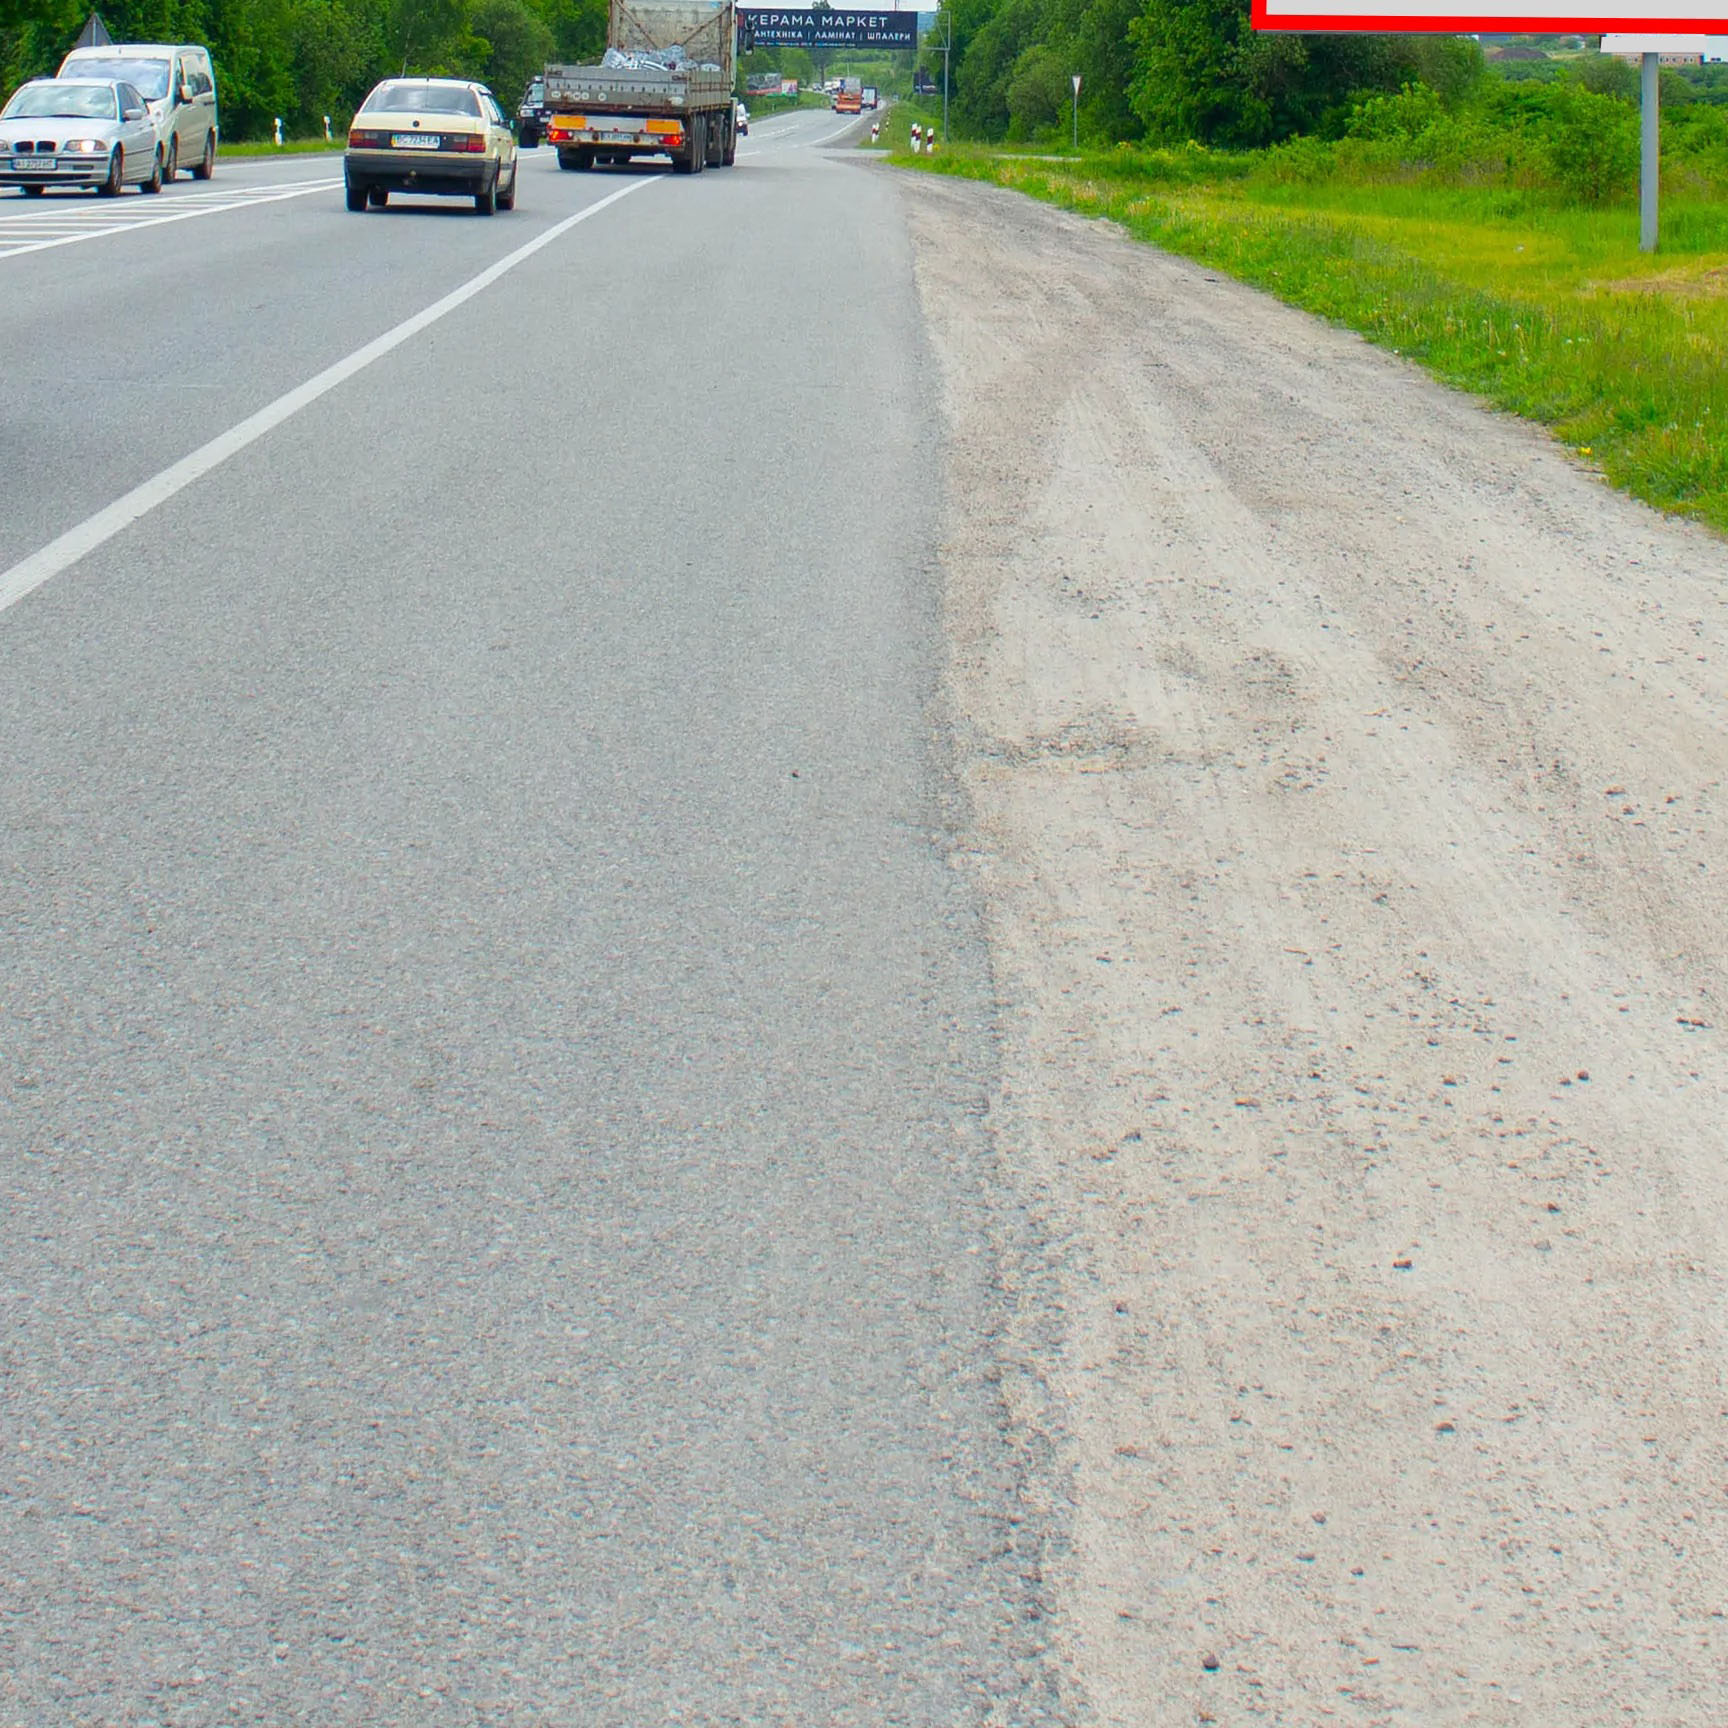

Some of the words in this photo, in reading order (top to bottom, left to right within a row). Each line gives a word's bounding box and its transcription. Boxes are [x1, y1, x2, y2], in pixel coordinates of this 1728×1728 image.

[821, 15, 888, 28] МАРКЕТ
[753, 30, 803, 39] АНТЕХНІКА
[814, 31, 856, 40] ЛАМІНАТ
[867, 32, 911, 41] ШПАЛЕРИ
